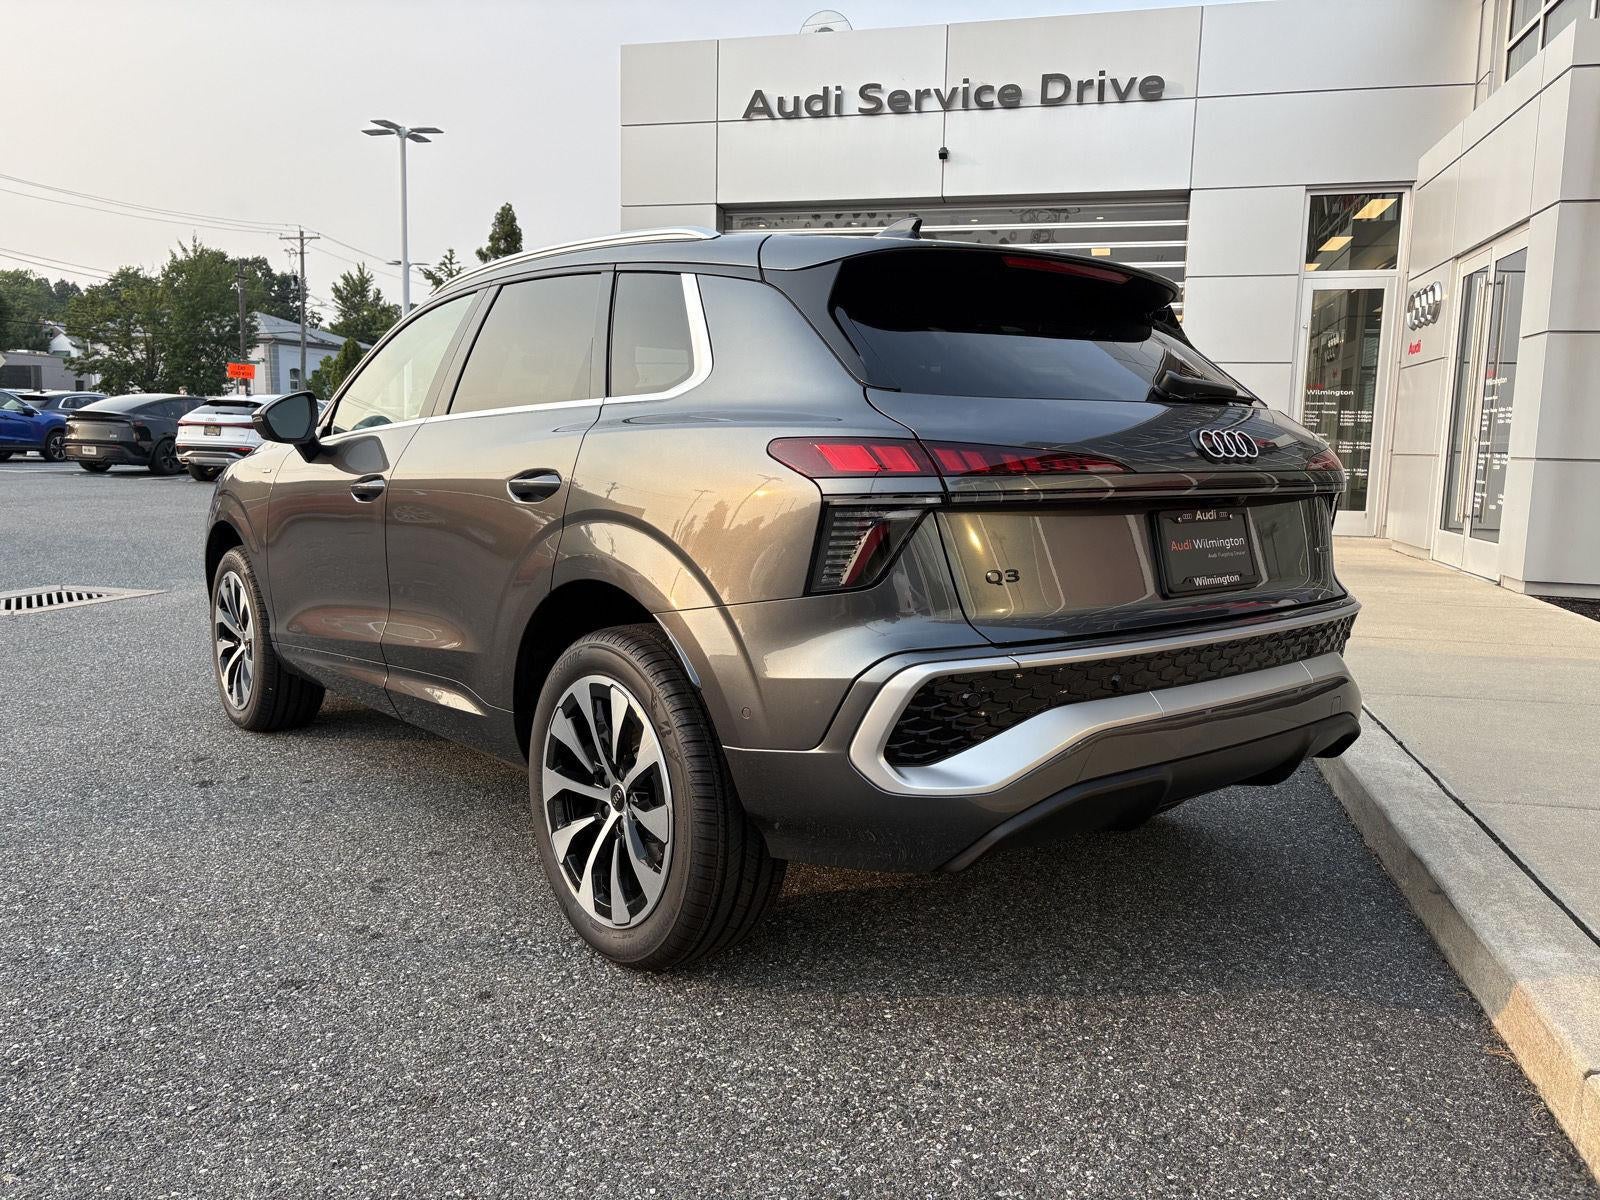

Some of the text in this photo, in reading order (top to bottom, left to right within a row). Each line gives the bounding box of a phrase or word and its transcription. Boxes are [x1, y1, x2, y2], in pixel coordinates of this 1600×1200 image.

[742, 70, 1166, 119] Audi Service Drive
[1408, 339, 1421, 355] Audi
[1307, 389, 1354, 397] Wilmington
[1195, 509, 1217, 520] Audi
[1171, 537, 1245, 551] Audi Wilmington
[986, 569, 1020, 585] Q3
[1194, 574, 1240, 586] Wilmington
